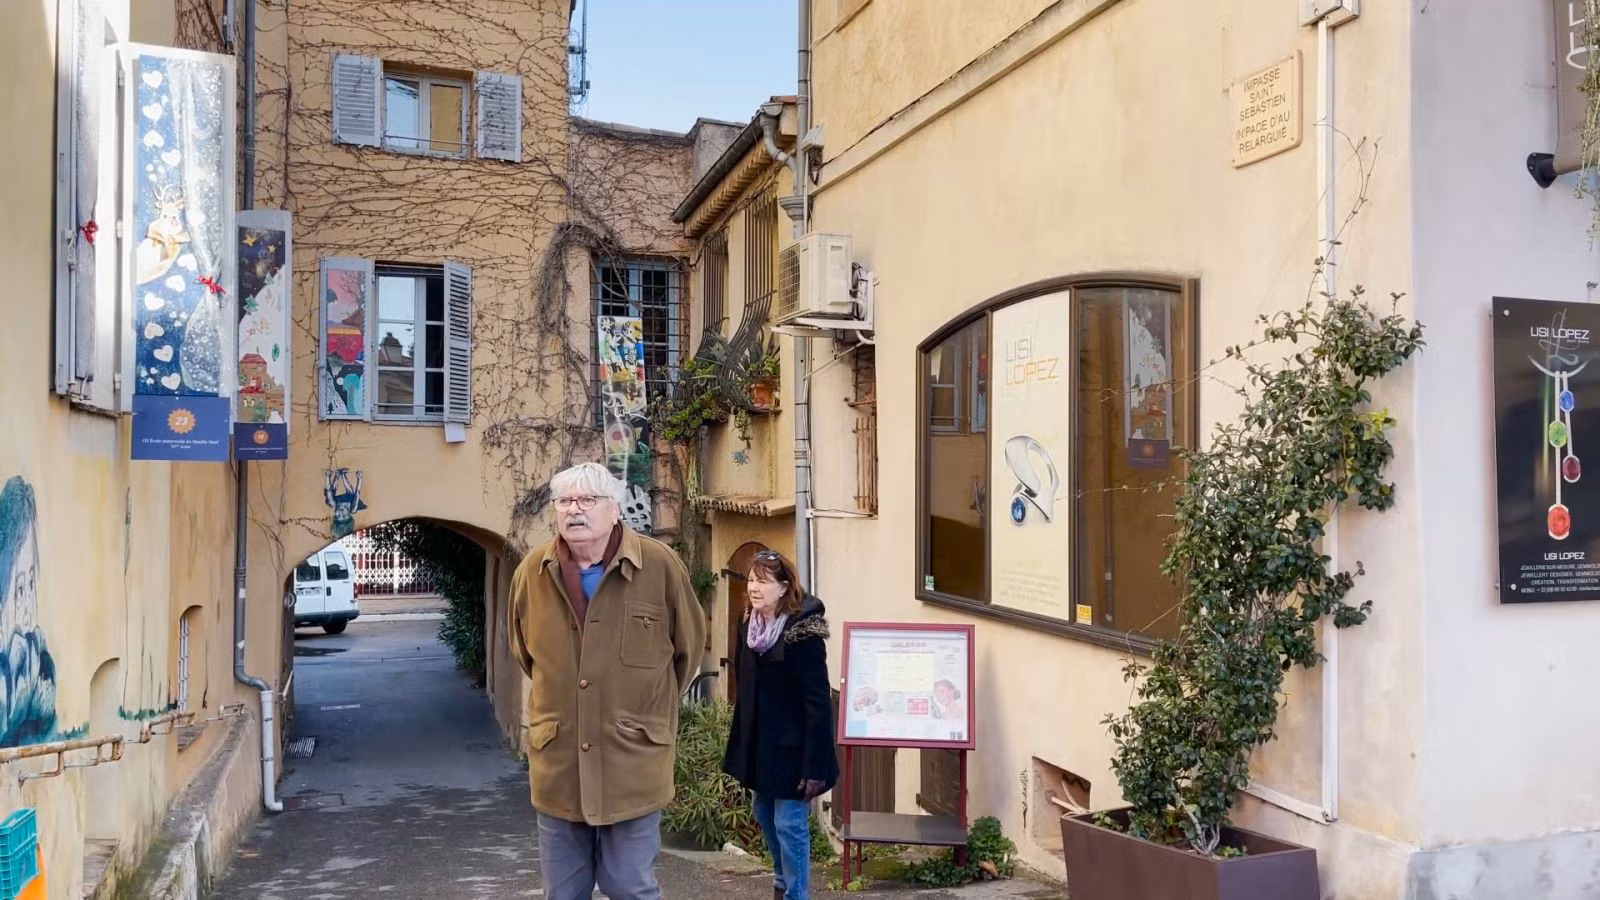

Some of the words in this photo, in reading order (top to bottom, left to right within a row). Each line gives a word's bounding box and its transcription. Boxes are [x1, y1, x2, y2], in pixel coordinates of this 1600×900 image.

[1243, 68, 1280, 92] IMPASSE
[1249, 83, 1275, 104] SAINT
[1530, 326, 1549, 337] LISI
[1552, 328, 1590, 339] LOPEZ
[1006, 337, 1032, 362] LISI
[1005, 357, 1060, 386] LOPEZ
[175, 416, 189, 426] 23
[1544, 552, 1557, 560] LISI
[1559, 551, 1585, 560] LOPEZ
